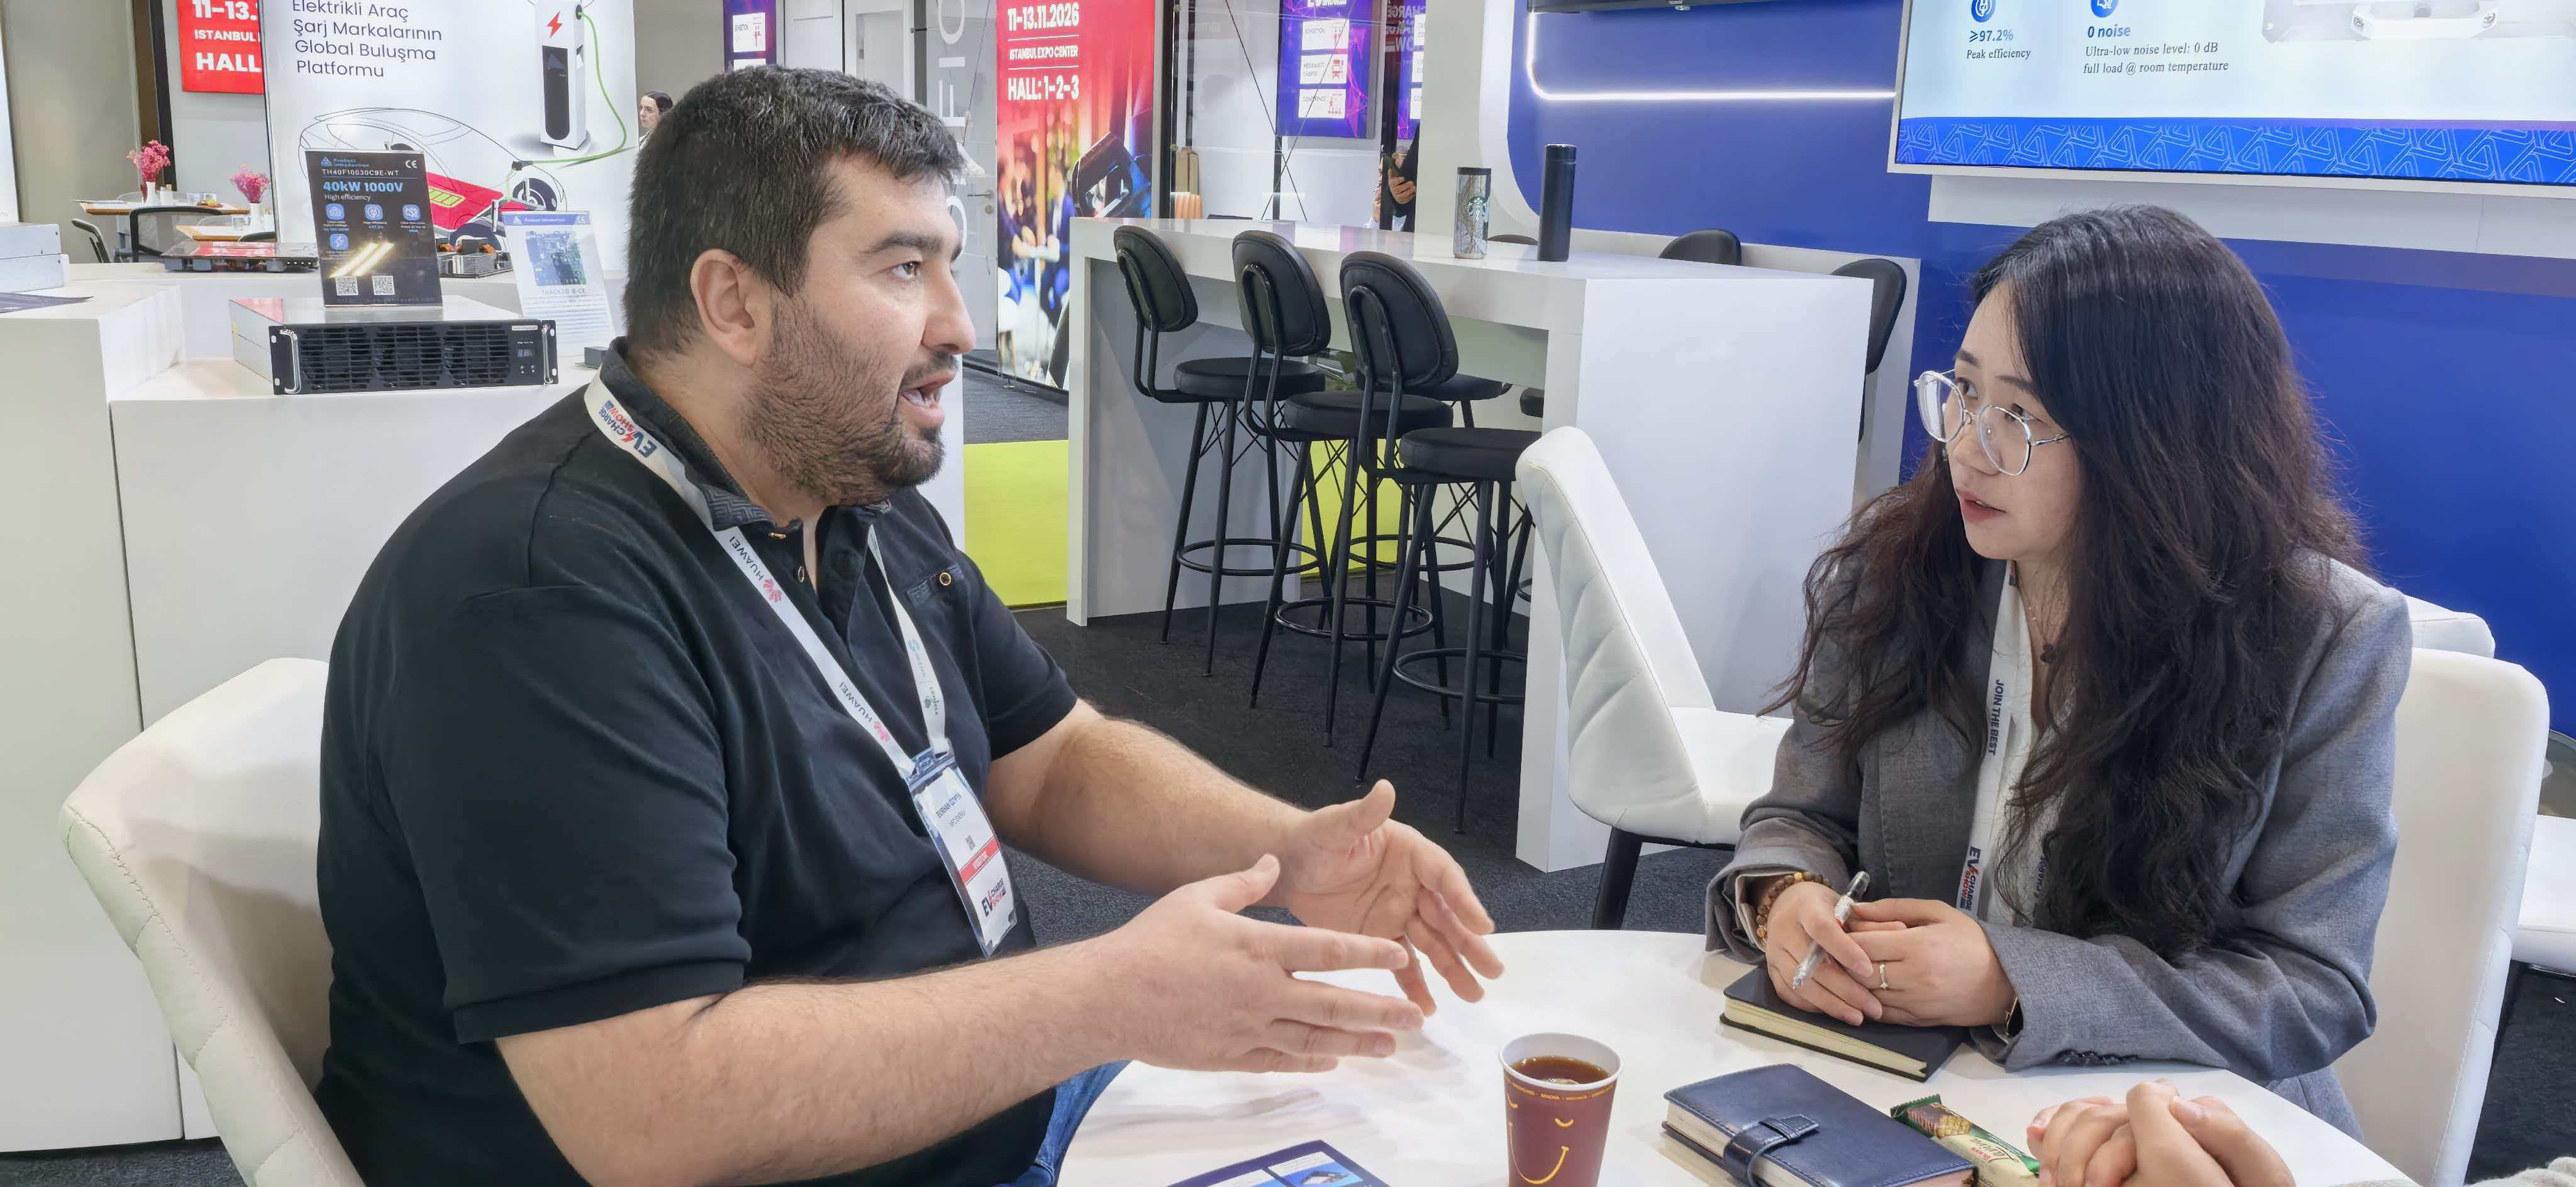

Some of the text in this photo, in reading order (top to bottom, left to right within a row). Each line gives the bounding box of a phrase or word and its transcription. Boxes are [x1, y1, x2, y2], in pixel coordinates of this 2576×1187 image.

[192, 0, 257, 21] 11-13.
[292, 0, 409, 23] Elektrikli Araç
[1008, 2, 1079, 31] 11-13.11.2026
[194, 30, 257, 41] ISTANBUL
[294, 19, 441, 40] Şarj Markalarının
[2087, 24, 2131, 38] 0 noise
[295, 40, 436, 63] Global Buluşma
[1009, 45, 1078, 60] ISTANBUL EXPO CENTER
[1967, 48, 2031, 60] Peak efficiency
[2085, 42, 2218, 57] Ultra-low noise level: 0 dB
[196, 52, 262, 72] HALL
[297, 60, 384, 77] Platformu
[2083, 62, 2229, 75] full load @ room temperature
[1008, 75, 1079, 101] HALL: 1-2-3
[323, 181, 403, 192] 40kW 1000V
[599, 406, 626, 436] CHARGE
[609, 407, 635, 432] SHOW
[730, 536, 764, 581] HUAWEI
[839, 682, 873, 722] HUAWEI
[1988, 679, 2004, 756] JOIN THE BEST
[1967, 846, 1981, 875] EV
[1962, 870, 1971, 899] SHOW
[1965, 875, 1977, 910] CHARGE
